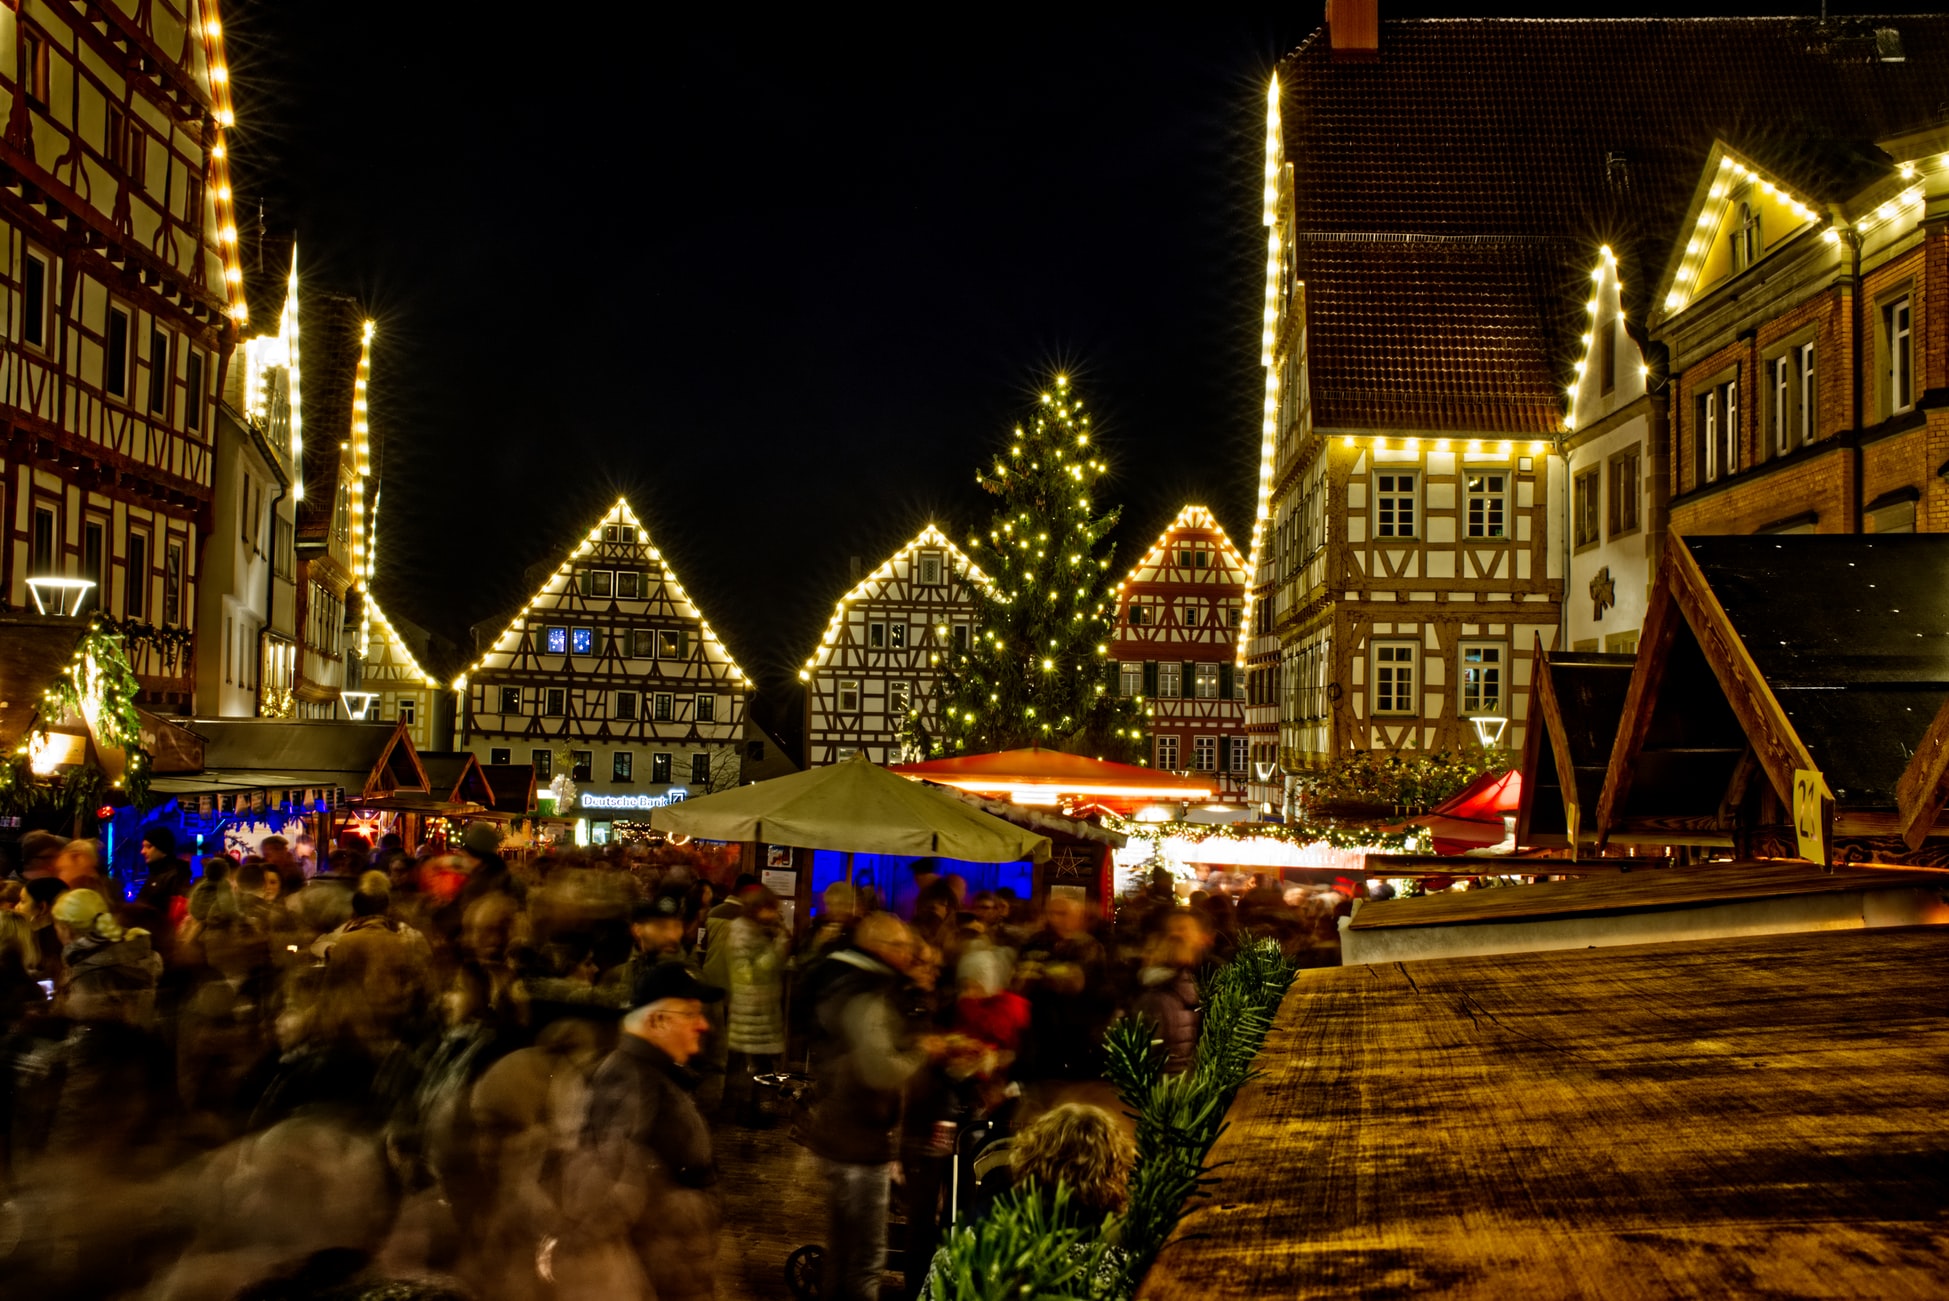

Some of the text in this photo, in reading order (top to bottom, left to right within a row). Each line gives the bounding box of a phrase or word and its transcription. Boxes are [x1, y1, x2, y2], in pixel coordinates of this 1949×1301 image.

[583, 794, 667, 808] Deutsche Bank
[1798, 779, 1817, 841] 21
